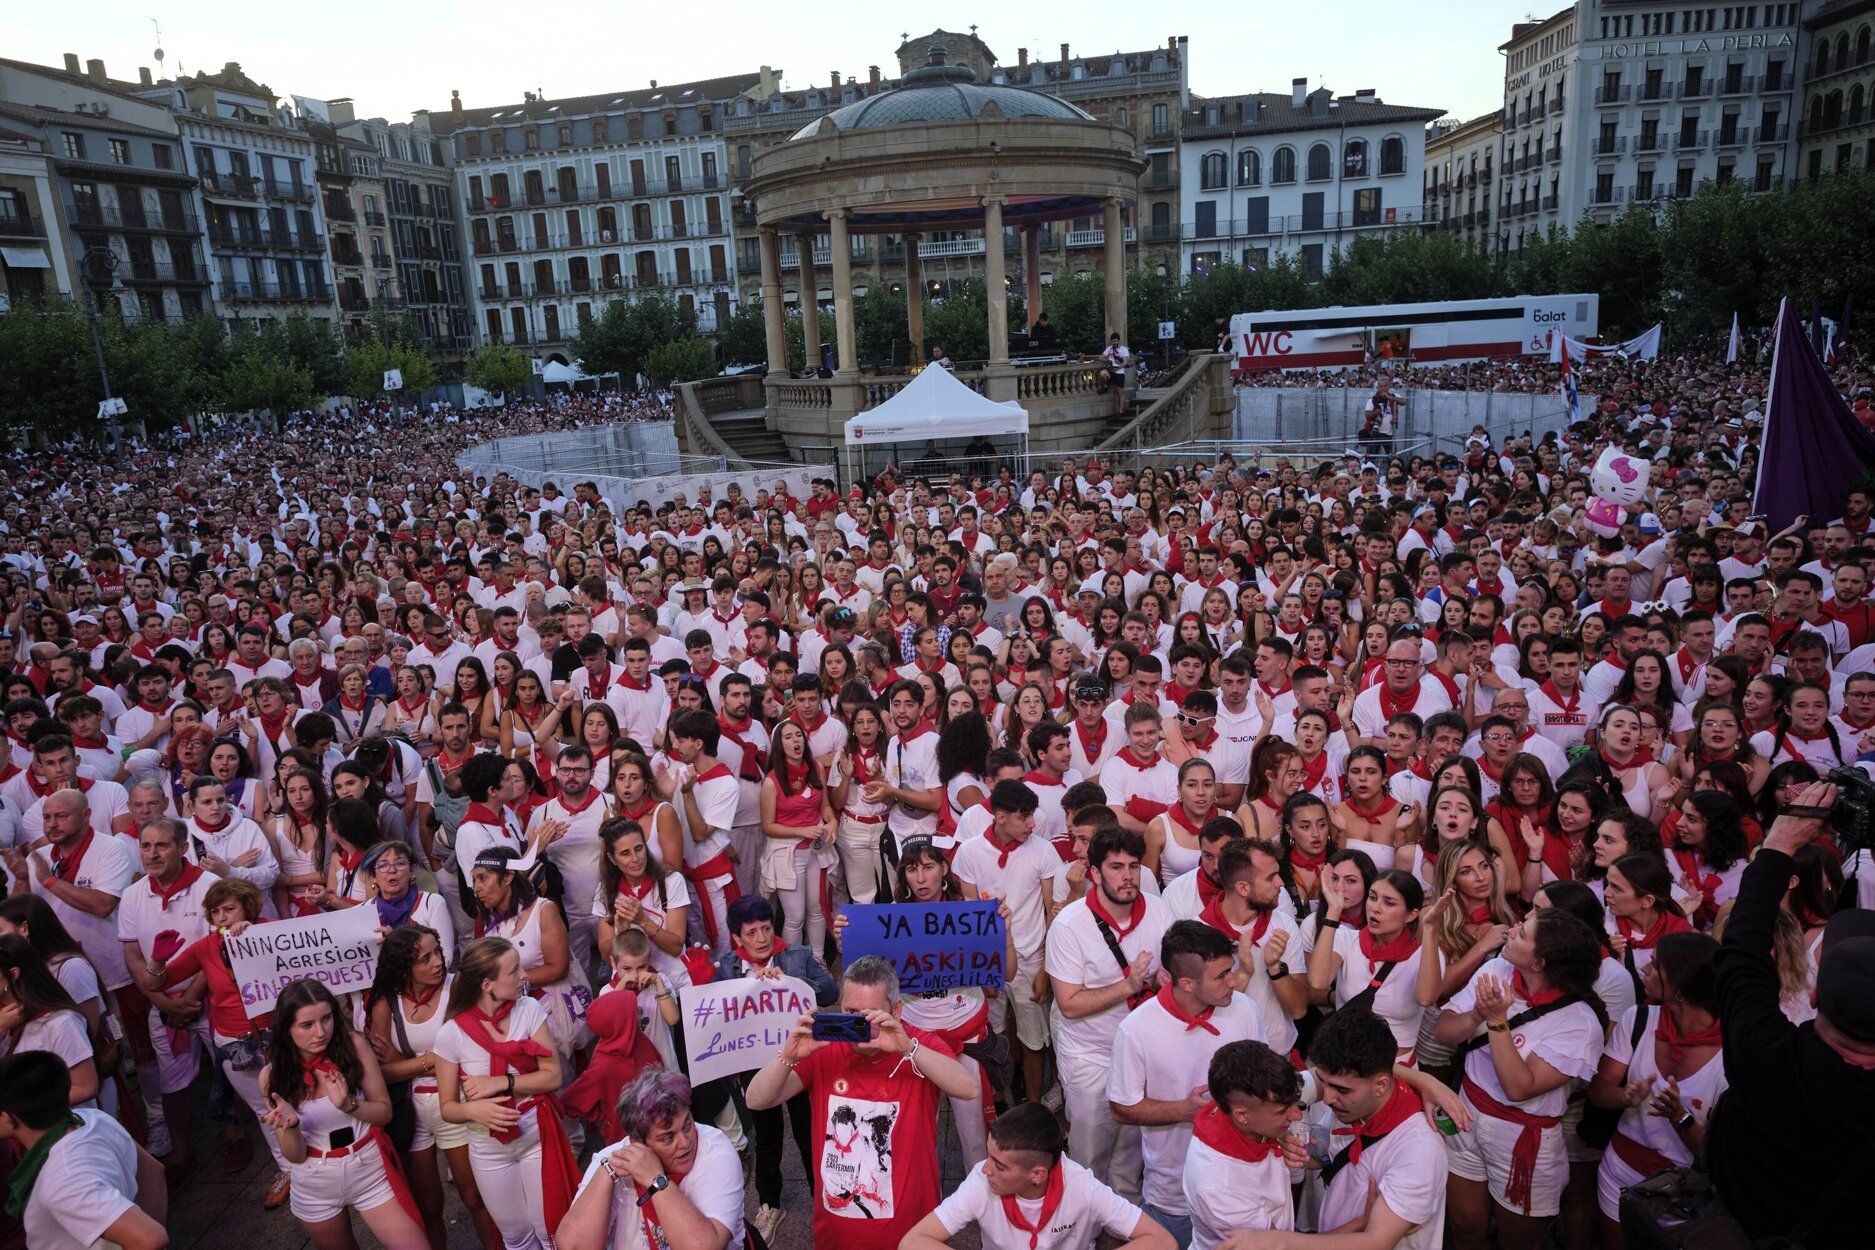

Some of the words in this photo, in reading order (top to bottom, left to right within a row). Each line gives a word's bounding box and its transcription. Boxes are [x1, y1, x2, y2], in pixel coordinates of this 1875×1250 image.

[1600, 41, 1668, 59] HOTEL
[1681, 39, 1710, 53] LA
[1722, 33, 1793, 50] PERLA
[1539, 55, 1567, 78] HOTEL
[1243, 331, 1293, 356] WC
[877, 913, 912, 939] YA
[925, 910, 998, 936] BASTA
